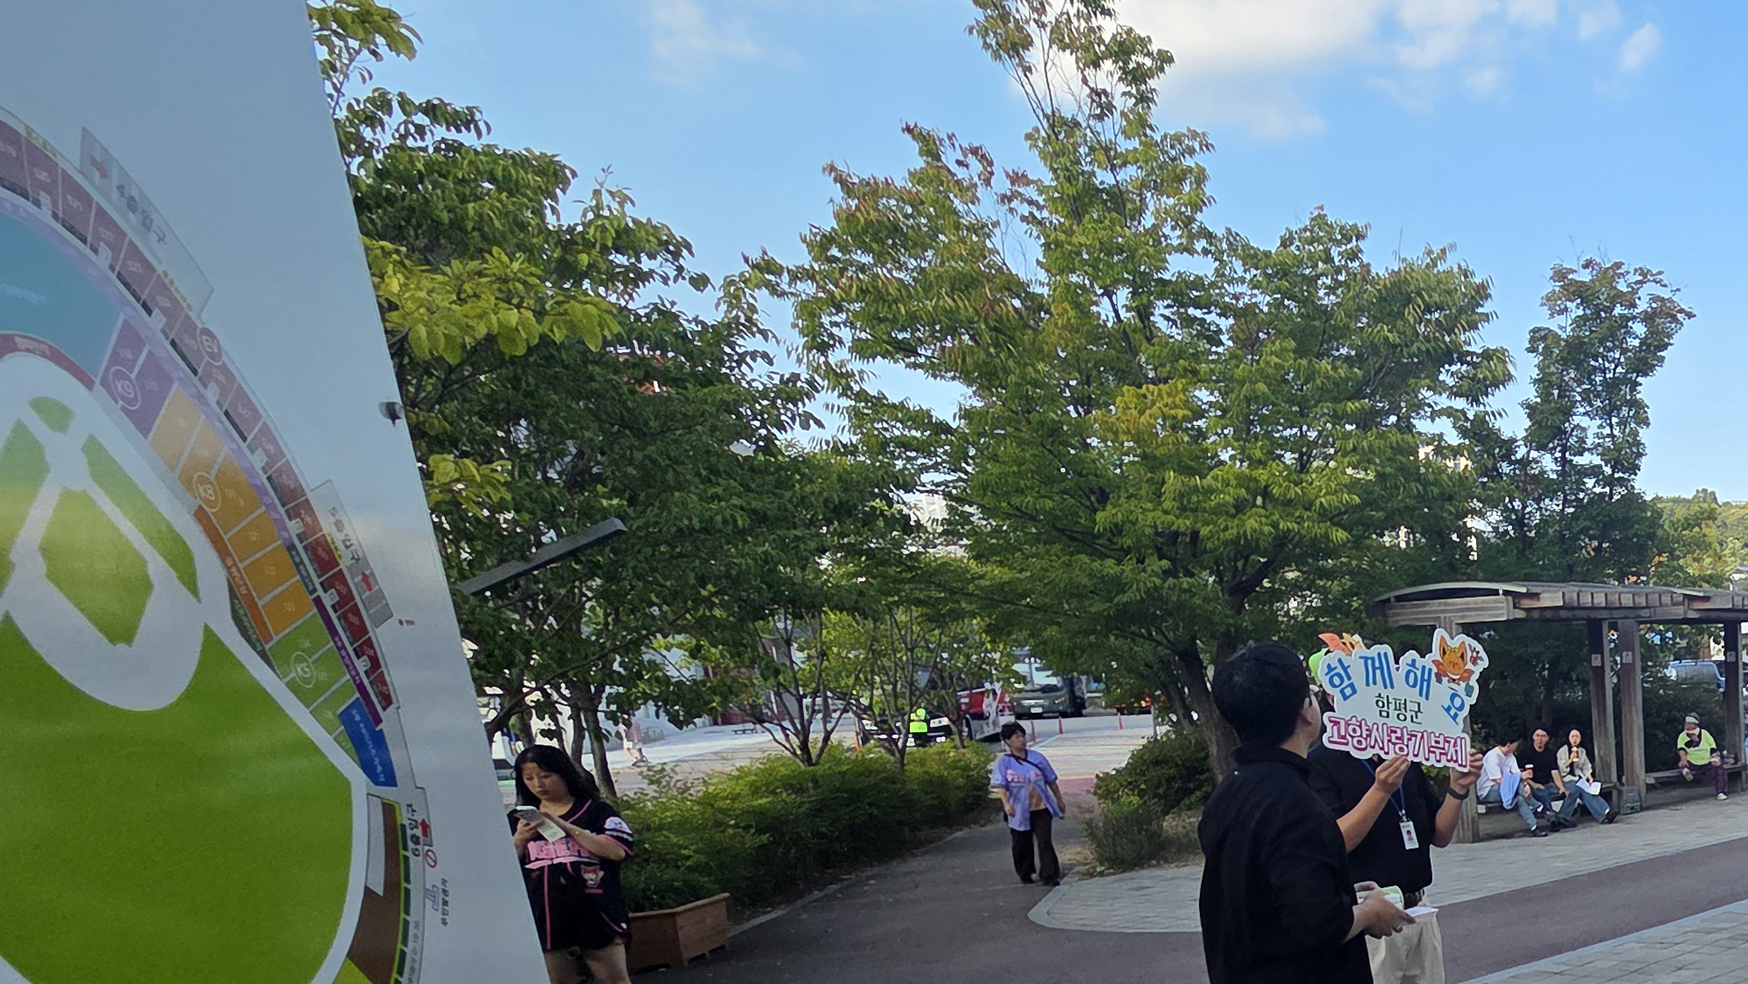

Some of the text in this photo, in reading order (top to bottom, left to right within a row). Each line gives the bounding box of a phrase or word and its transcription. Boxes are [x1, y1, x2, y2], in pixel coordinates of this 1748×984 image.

[1325, 651, 1466, 726] 함께해요
[1375, 692, 1423, 725] 함평군
[1328, 715, 1468, 768] 고향사랑기부제
